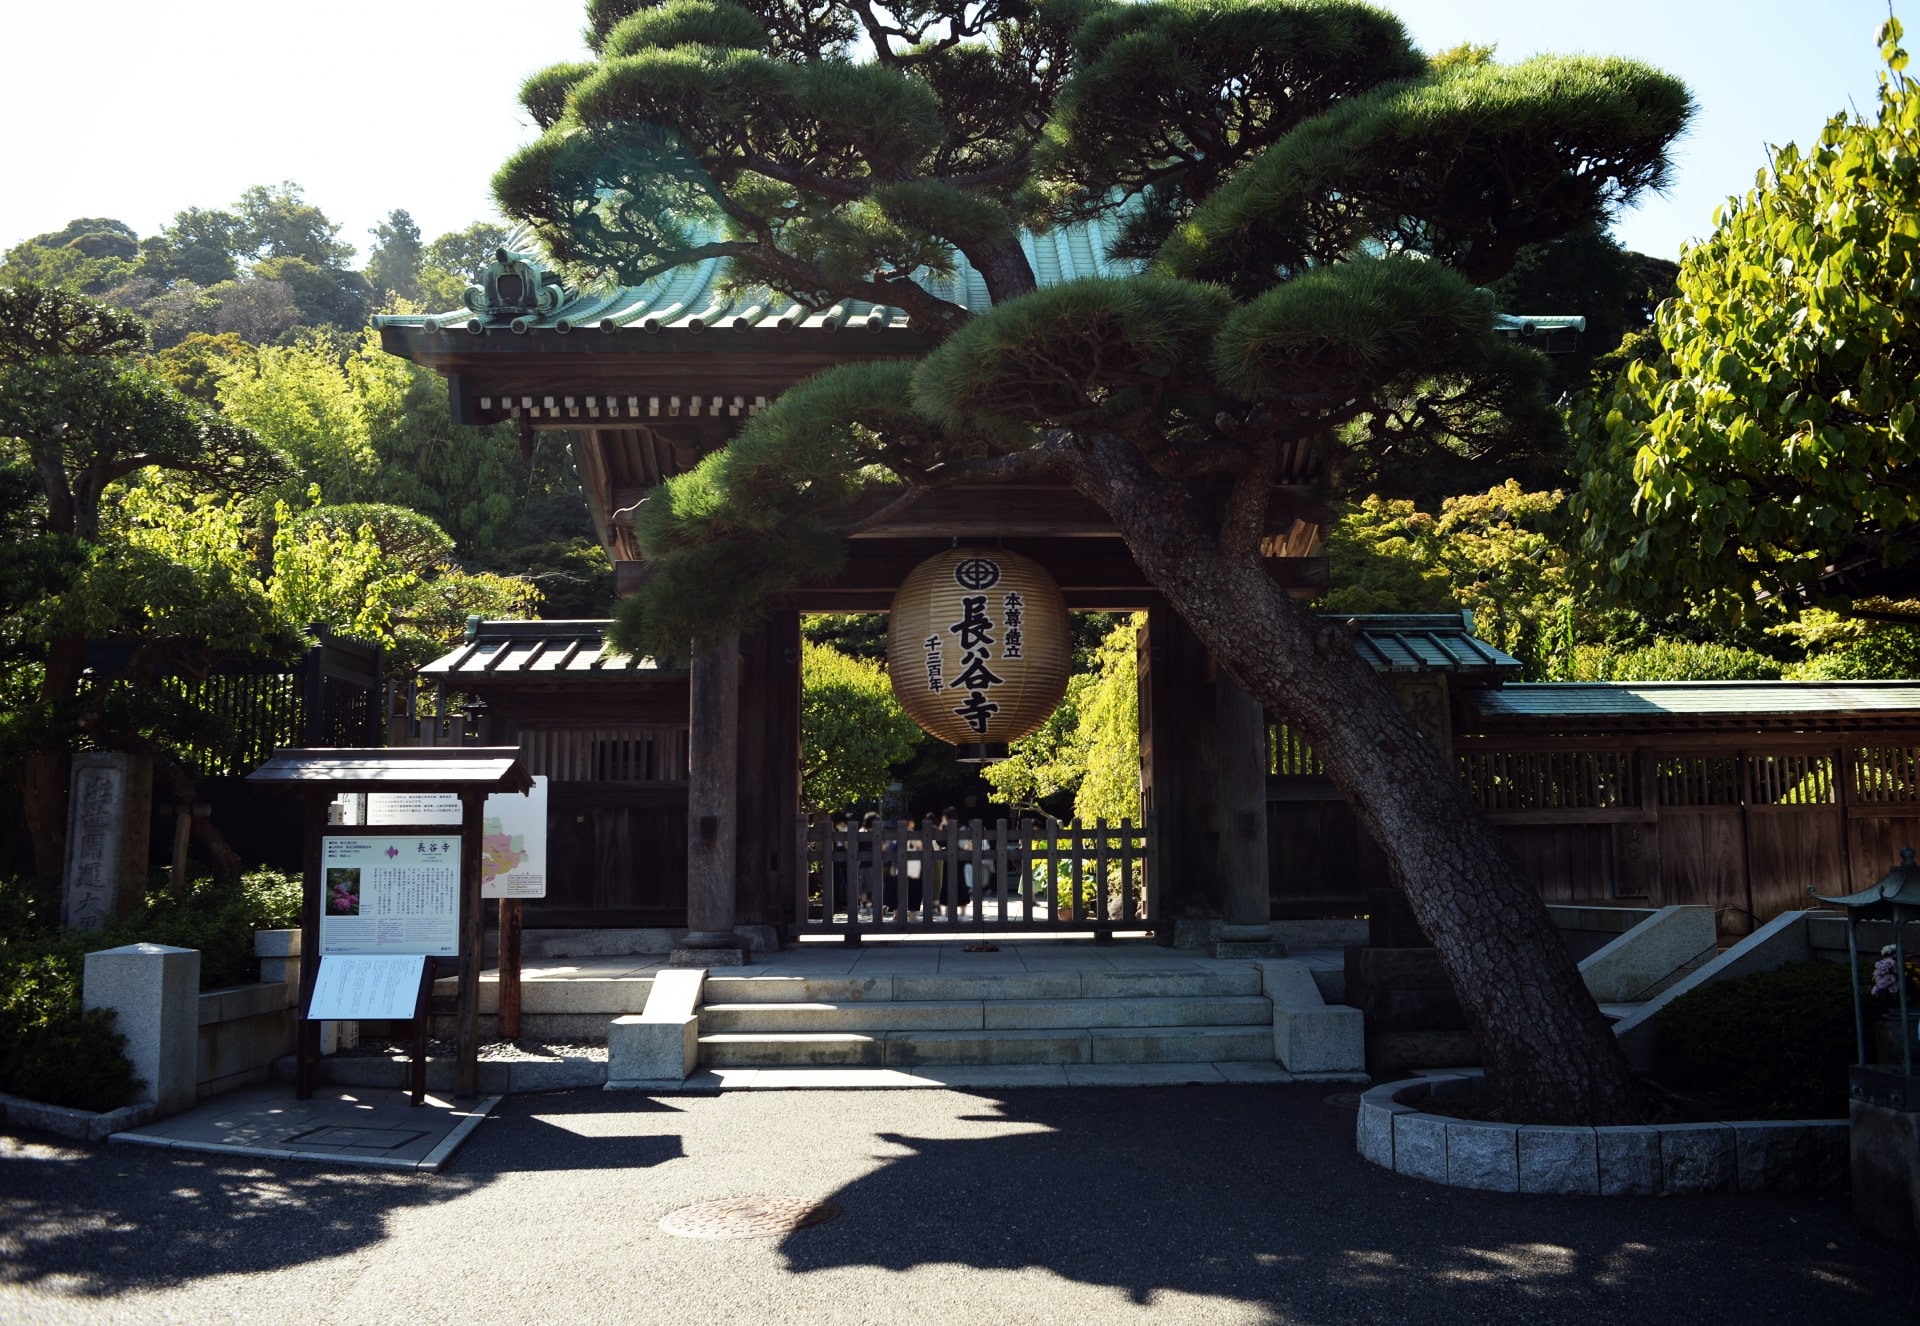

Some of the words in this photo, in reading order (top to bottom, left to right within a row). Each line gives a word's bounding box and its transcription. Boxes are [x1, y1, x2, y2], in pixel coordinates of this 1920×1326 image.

[1004, 592, 1023, 659] 本尊造立
[925, 635, 943, 693] 千三百年
[951, 596, 1004, 734] 長谷寺
[417, 842, 450, 853] 長谷寺
